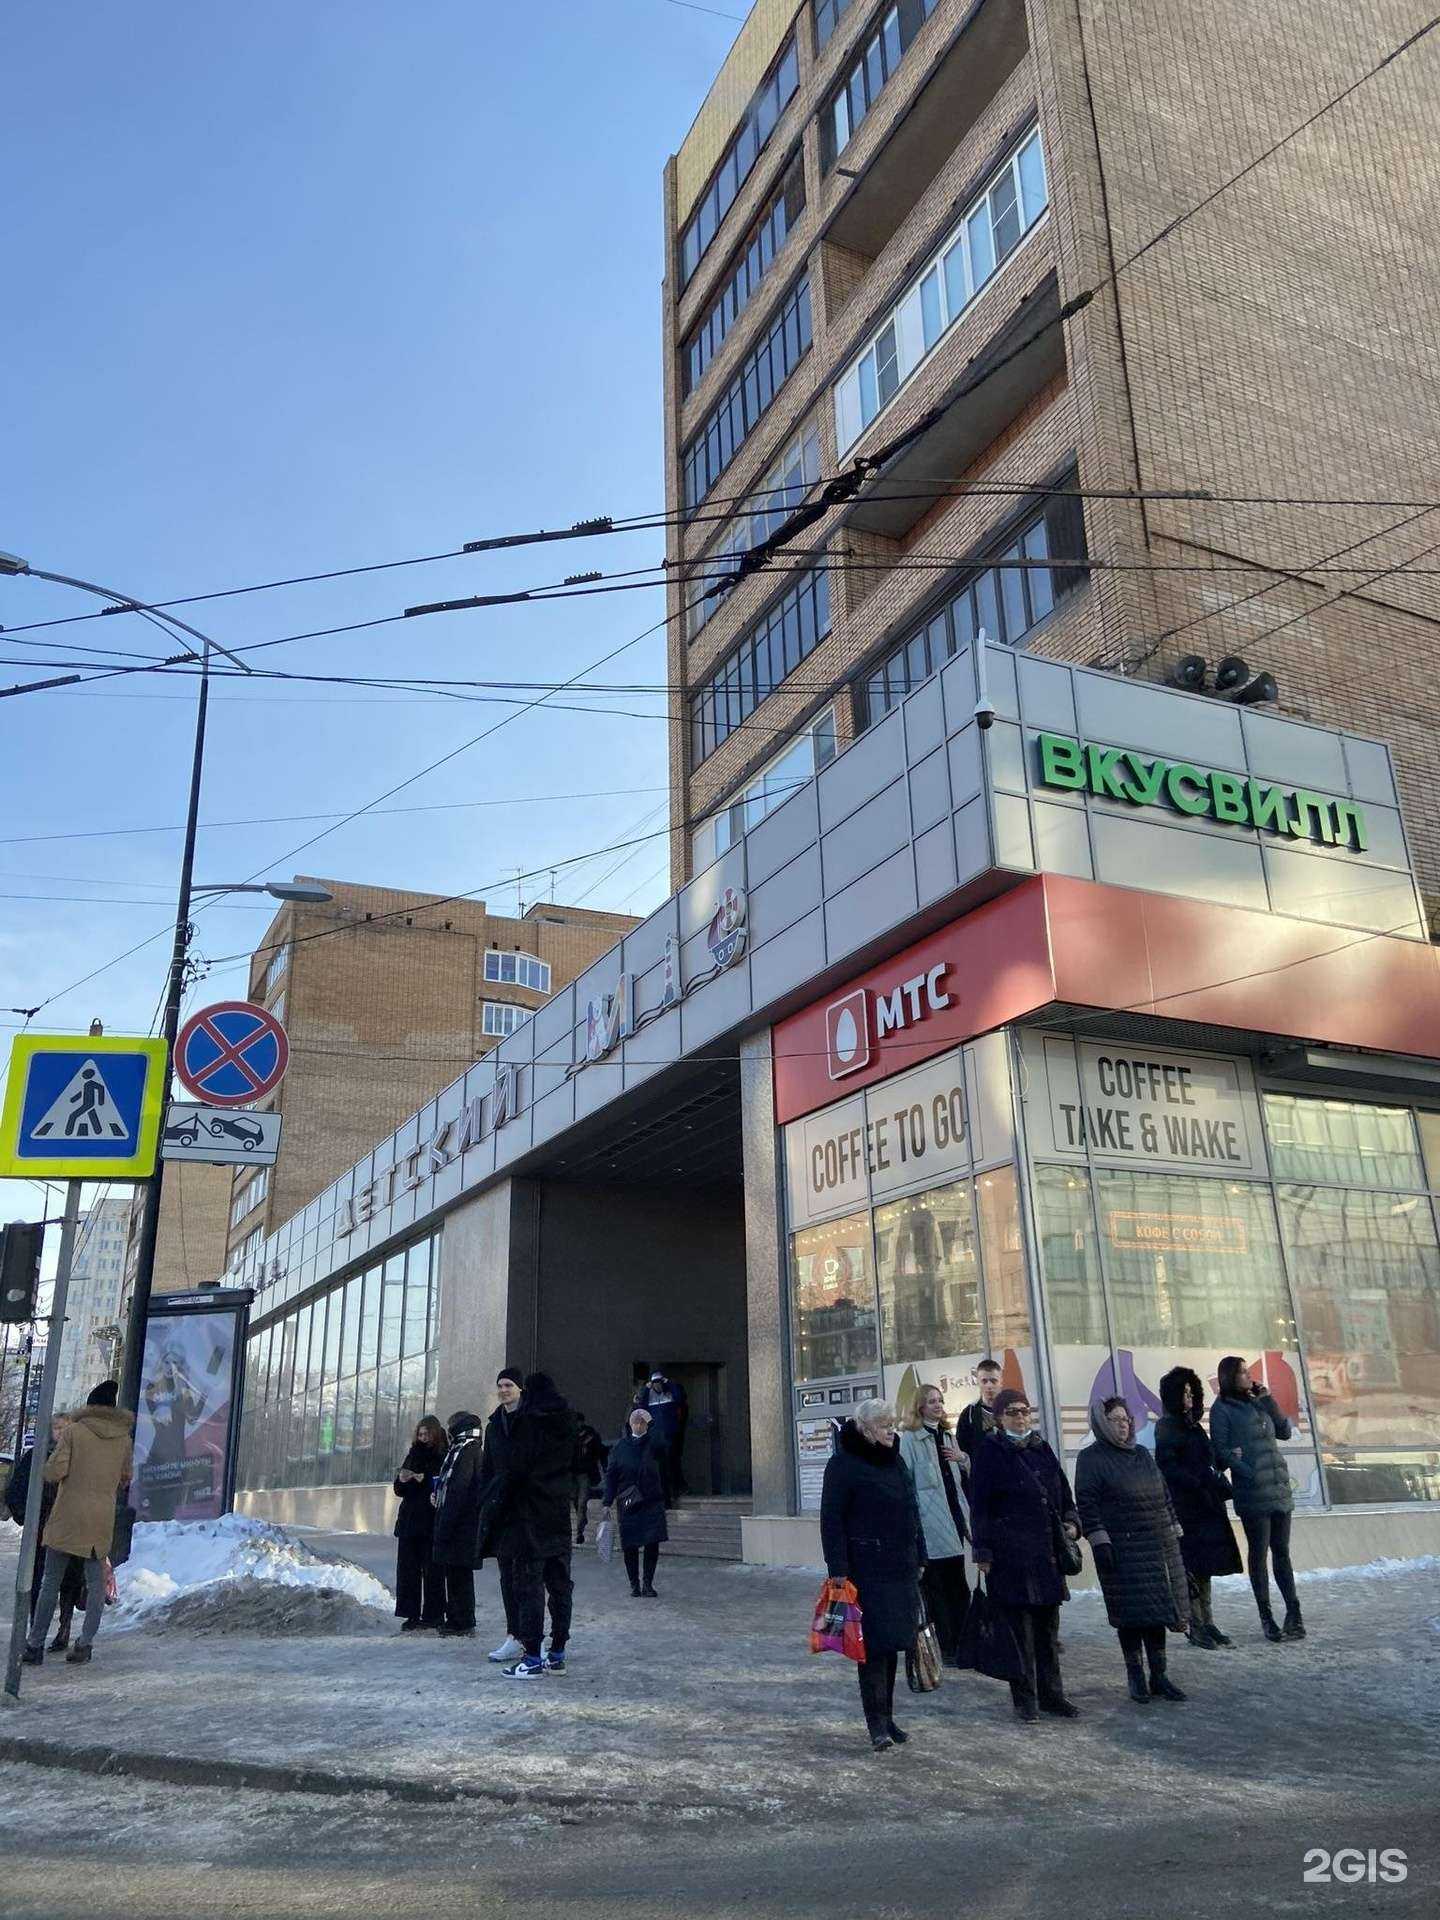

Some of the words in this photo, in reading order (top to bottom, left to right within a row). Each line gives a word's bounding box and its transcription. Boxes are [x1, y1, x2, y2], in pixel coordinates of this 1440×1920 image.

[1038, 733, 1368, 851] ВКУСВИЛЛ
[875, 962, 950, 1038] МТС
[1098, 1056, 1196, 1106] COFFEE
[335, 1063, 517, 1239] ДЕТСКИЙ
[812, 1118, 890, 1194] COFFEE
[894, 1103, 925, 1162] TO
[932, 1087, 966, 1150] GO
[1059, 1103, 1135, 1151] TAKE
[1139, 1112, 1159, 1153] &
[1163, 1115, 1241, 1161] WAKE
